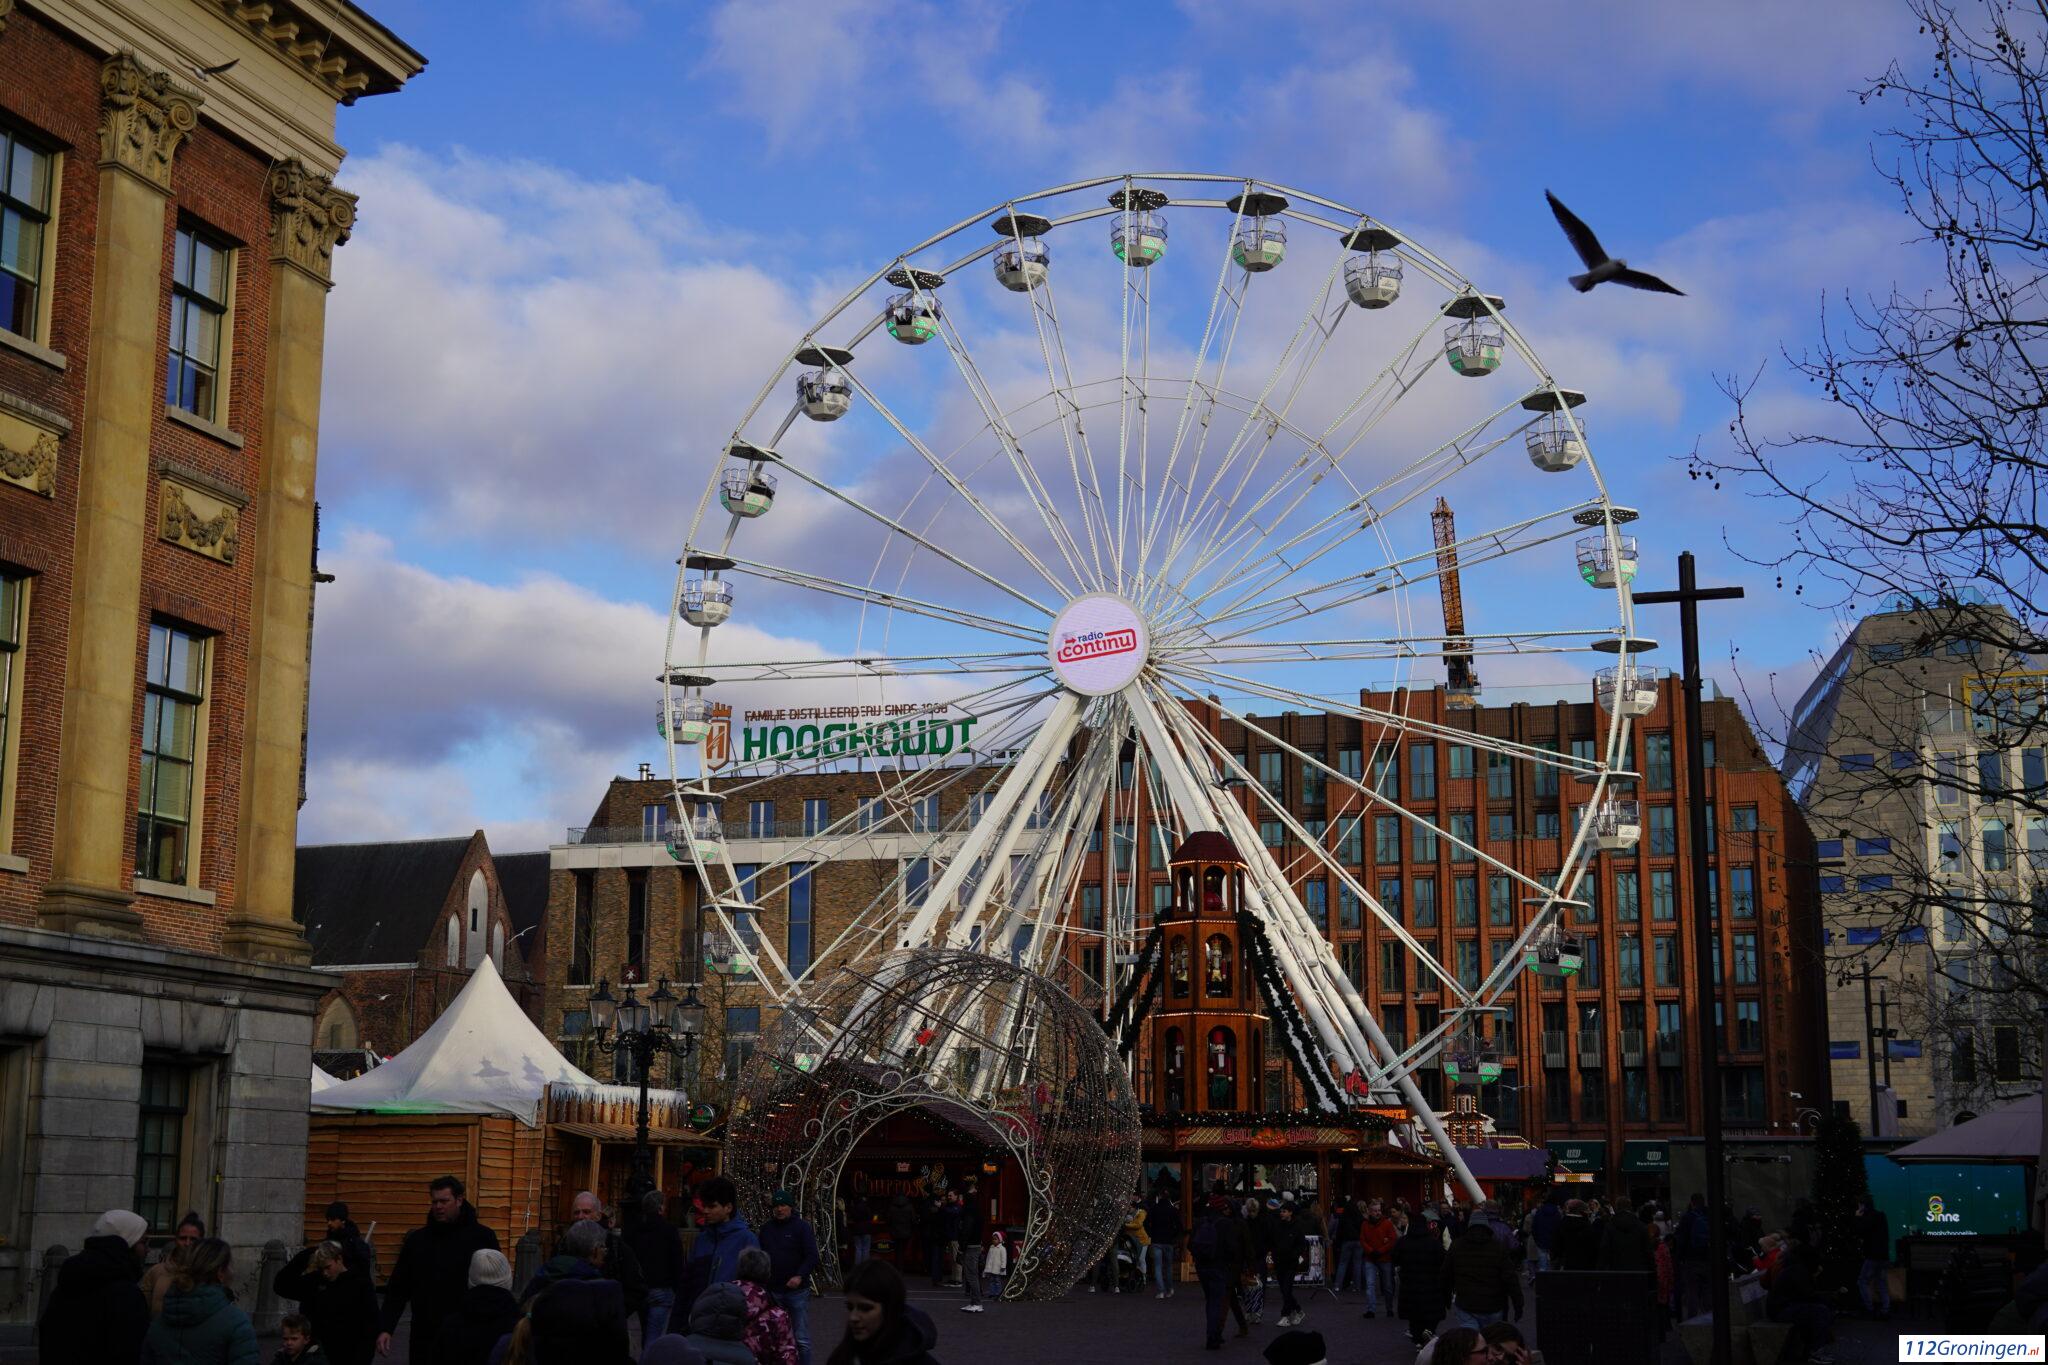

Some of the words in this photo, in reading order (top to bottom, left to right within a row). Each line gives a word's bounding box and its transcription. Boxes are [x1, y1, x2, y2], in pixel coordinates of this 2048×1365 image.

[1078, 631, 1104, 643] radio
[1063, 635, 1131, 657] continu
[744, 709, 786, 721] FAMILIE
[885, 704, 918, 716] SINDS
[743, 718, 978, 762] HOOGHOUDT
[1926, 1210, 1961, 1223] Sinne
